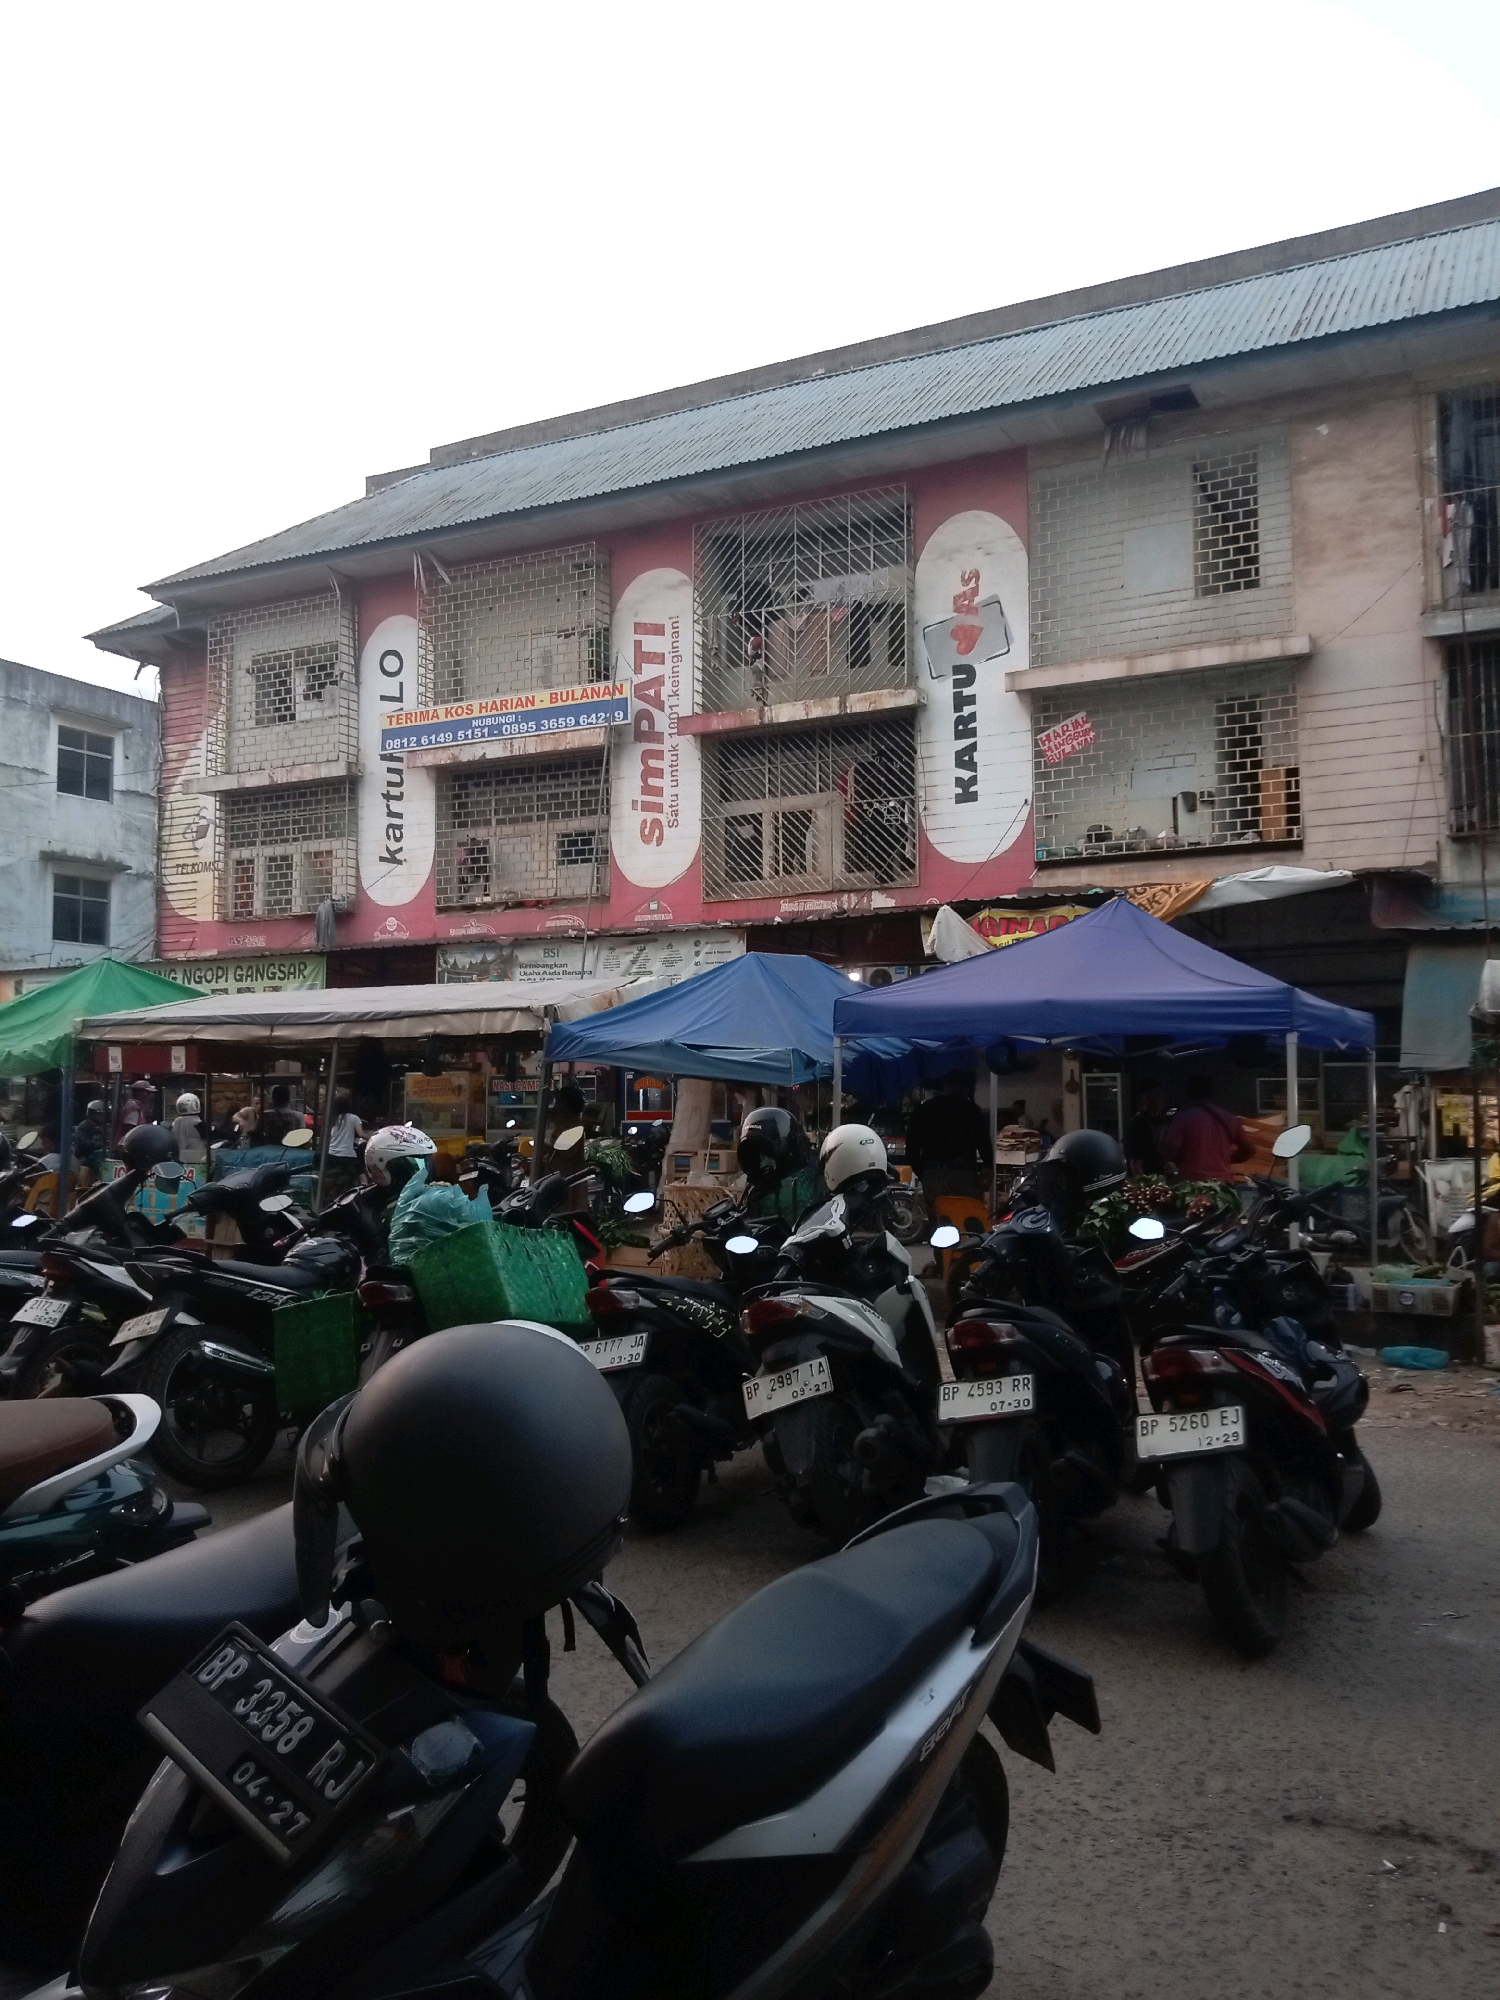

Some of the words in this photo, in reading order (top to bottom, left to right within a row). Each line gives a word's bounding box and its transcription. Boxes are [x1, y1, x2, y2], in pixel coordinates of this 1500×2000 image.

[386, 711, 440, 726] TERIMA
[444, 705, 474, 718] KOS
[479, 695, 536, 714] HARIAN
[549, 683, 624, 705] BULANAN
[472, 714, 516, 728] HUBUNGI
[385, 737, 418, 750] 0812
[420, 732, 453, 745] 6149
[457, 729, 489, 742] 5151
[502, 722, 536, 736] 0895
[540, 717, 575, 730] 3659
[632, 622, 666, 847] simPATI
[952, 663, 978, 805] KARTU
[667, 742, 679, 788] untuk
[667, 794, 679, 829] Satu
[543, 947, 560, 958] BSI
[181, 965, 229, 985] NGOPI
[233, 961, 308, 983] GANGSAR
[492, 1079, 513, 1091] NASI
[595, 1338, 623, 1354] 6177
[630, 1335, 645, 1348] JA
[745, 1382, 760, 1401] BP
[769, 1368, 800, 1392] 2987
[942, 1386, 960, 1401] BP
[967, 1380, 1003, 1398] 4593
[1012, 1376, 1031, 1392] RR
[1140, 1419, 1159, 1437] BP
[1169, 1412, 1209, 1432] 5260
[1220, 1408, 1240, 1426] EJ
[198, 1646, 249, 1692] BP
[306, 1739, 365, 1800] RJ
